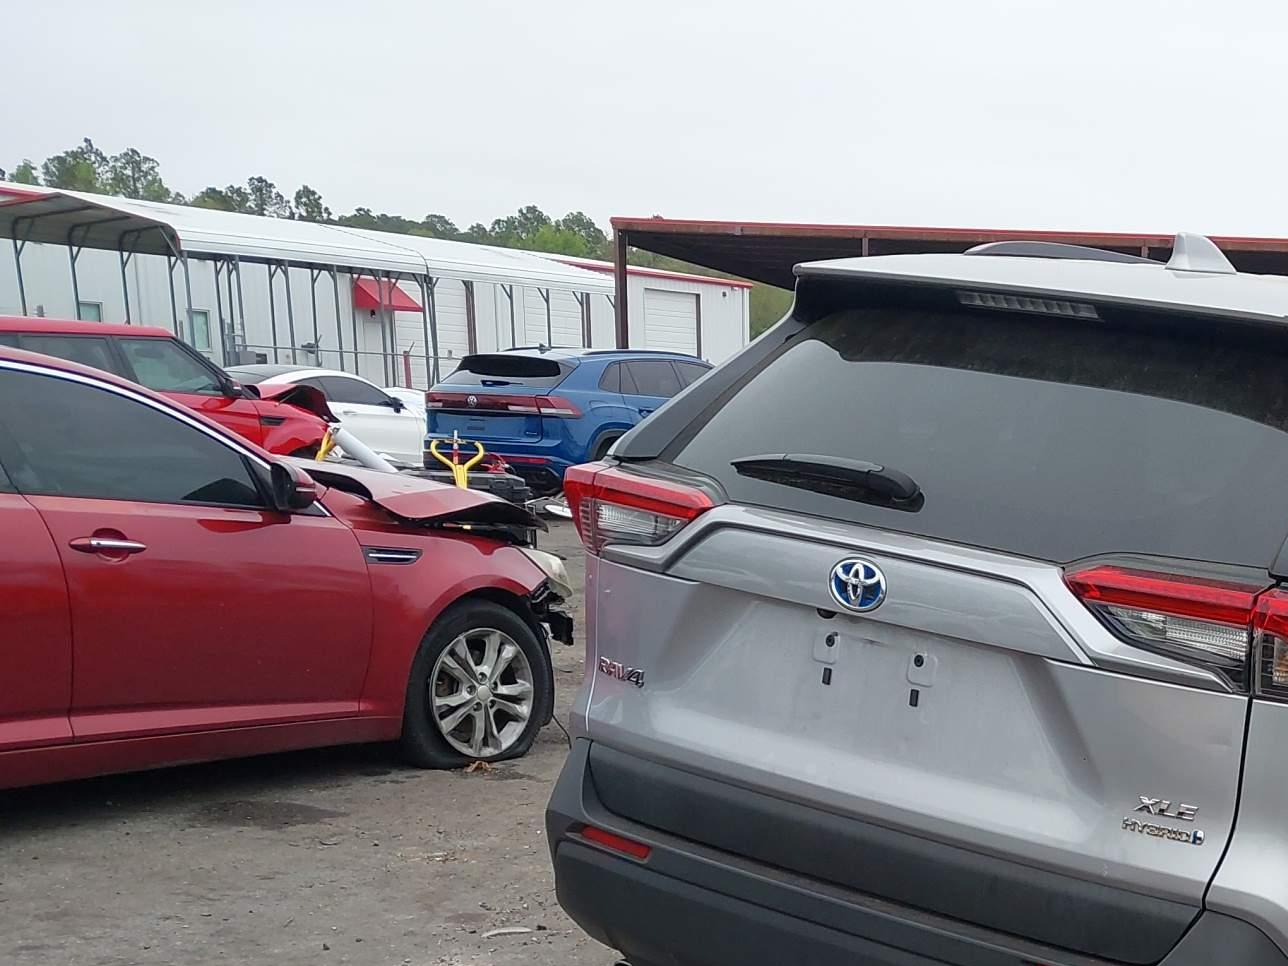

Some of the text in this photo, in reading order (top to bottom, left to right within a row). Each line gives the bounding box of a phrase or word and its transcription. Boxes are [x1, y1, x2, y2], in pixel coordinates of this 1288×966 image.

[599, 656, 644, 688] RAV4
[1133, 795, 1199, 821] XLE
[1121, 816, 1192, 845] HYBRID
